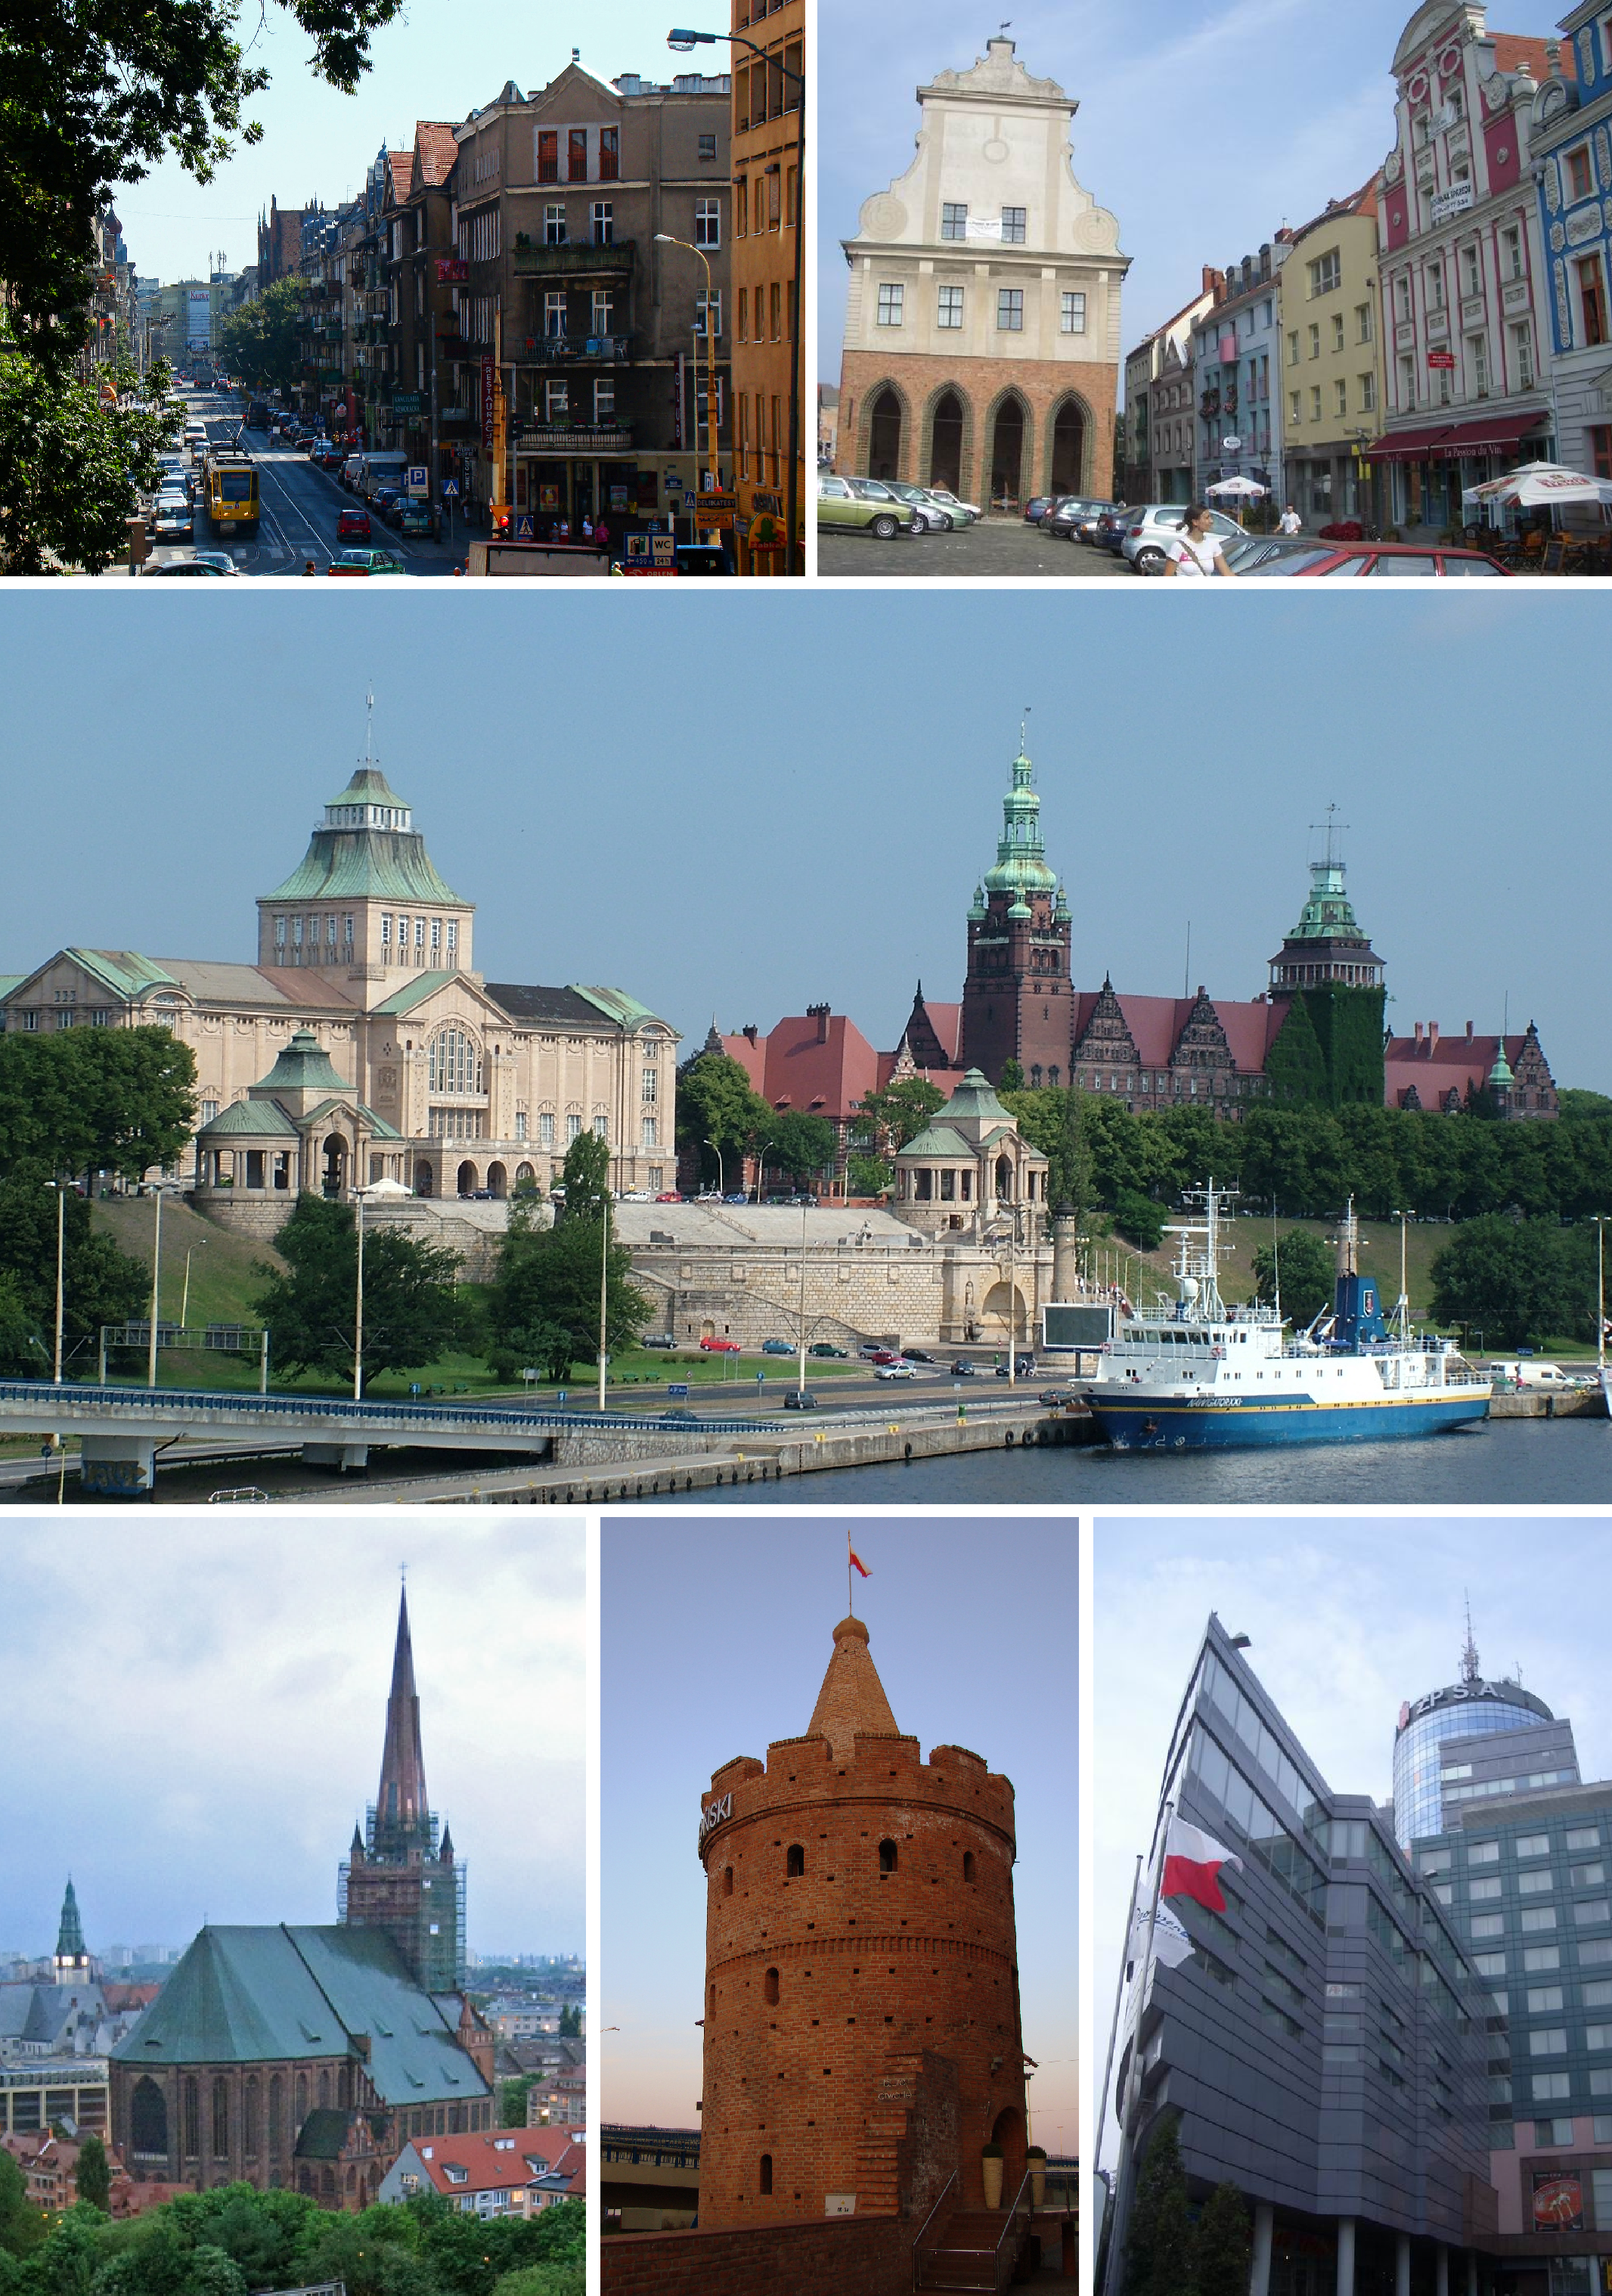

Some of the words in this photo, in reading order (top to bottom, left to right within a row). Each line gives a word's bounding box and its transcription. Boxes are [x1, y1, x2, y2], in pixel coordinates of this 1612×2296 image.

[190, 290, 209, 299] Kurier
[485, 366, 494, 448] RESTAURACJA
[1445, 447, 1452, 458] La
[1453, 446, 1477, 457] Passion
[1477, 444, 1487, 456] du
[1488, 444, 1502, 455] Vin
[414, 470, 423, 482] P
[654, 540, 671, 549] WC
[1452, 1681, 1505, 1699] S.A.
